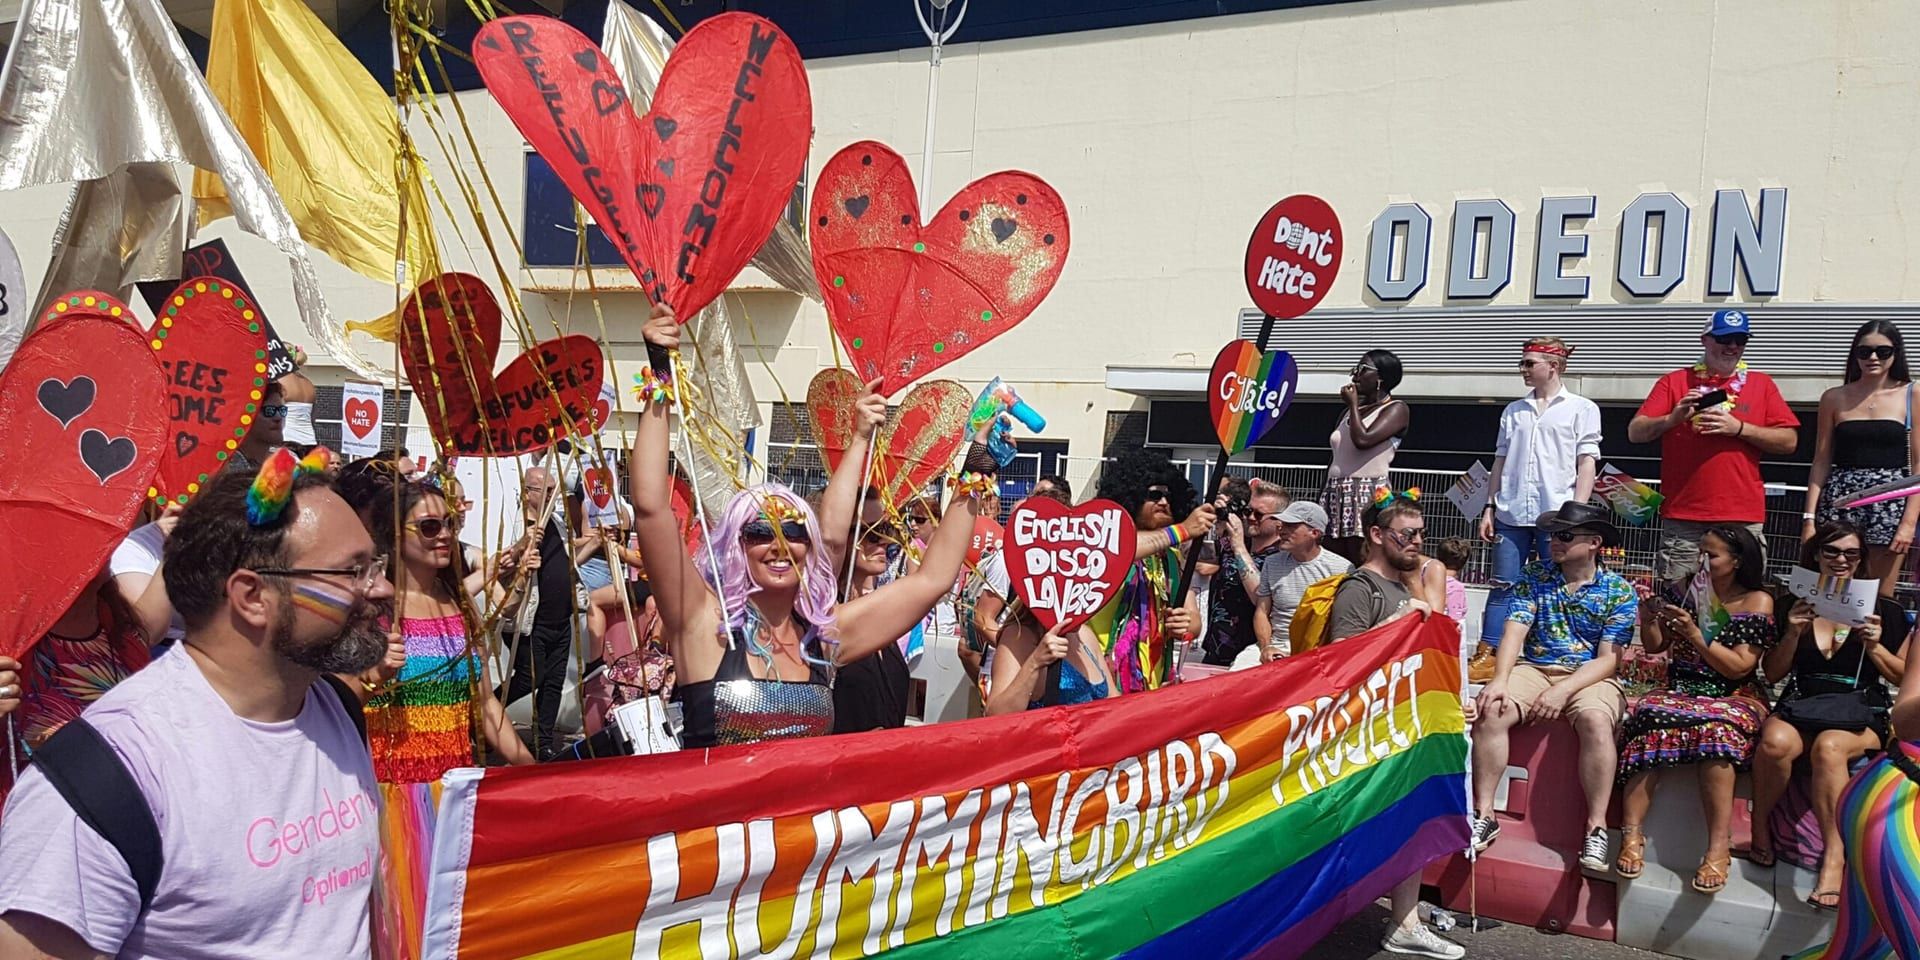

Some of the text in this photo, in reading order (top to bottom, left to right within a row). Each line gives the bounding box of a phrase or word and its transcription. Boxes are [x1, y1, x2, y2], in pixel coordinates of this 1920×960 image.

[677, 22, 777, 284] WELCOME
[1366, 188, 1788, 301] ODEON
[1257, 255, 1316, 299] Hate
[351, 418, 371, 427] HATE
[355, 409, 367, 418] NO
[1025, 547, 1107, 579] DISCO
[1796, 583, 1865, 607] FOCUS
[246, 787, 363, 868] Gender
[631, 654, 1424, 960] HUMMINGBIRD PROJECT
[302, 847, 372, 906] Optional
